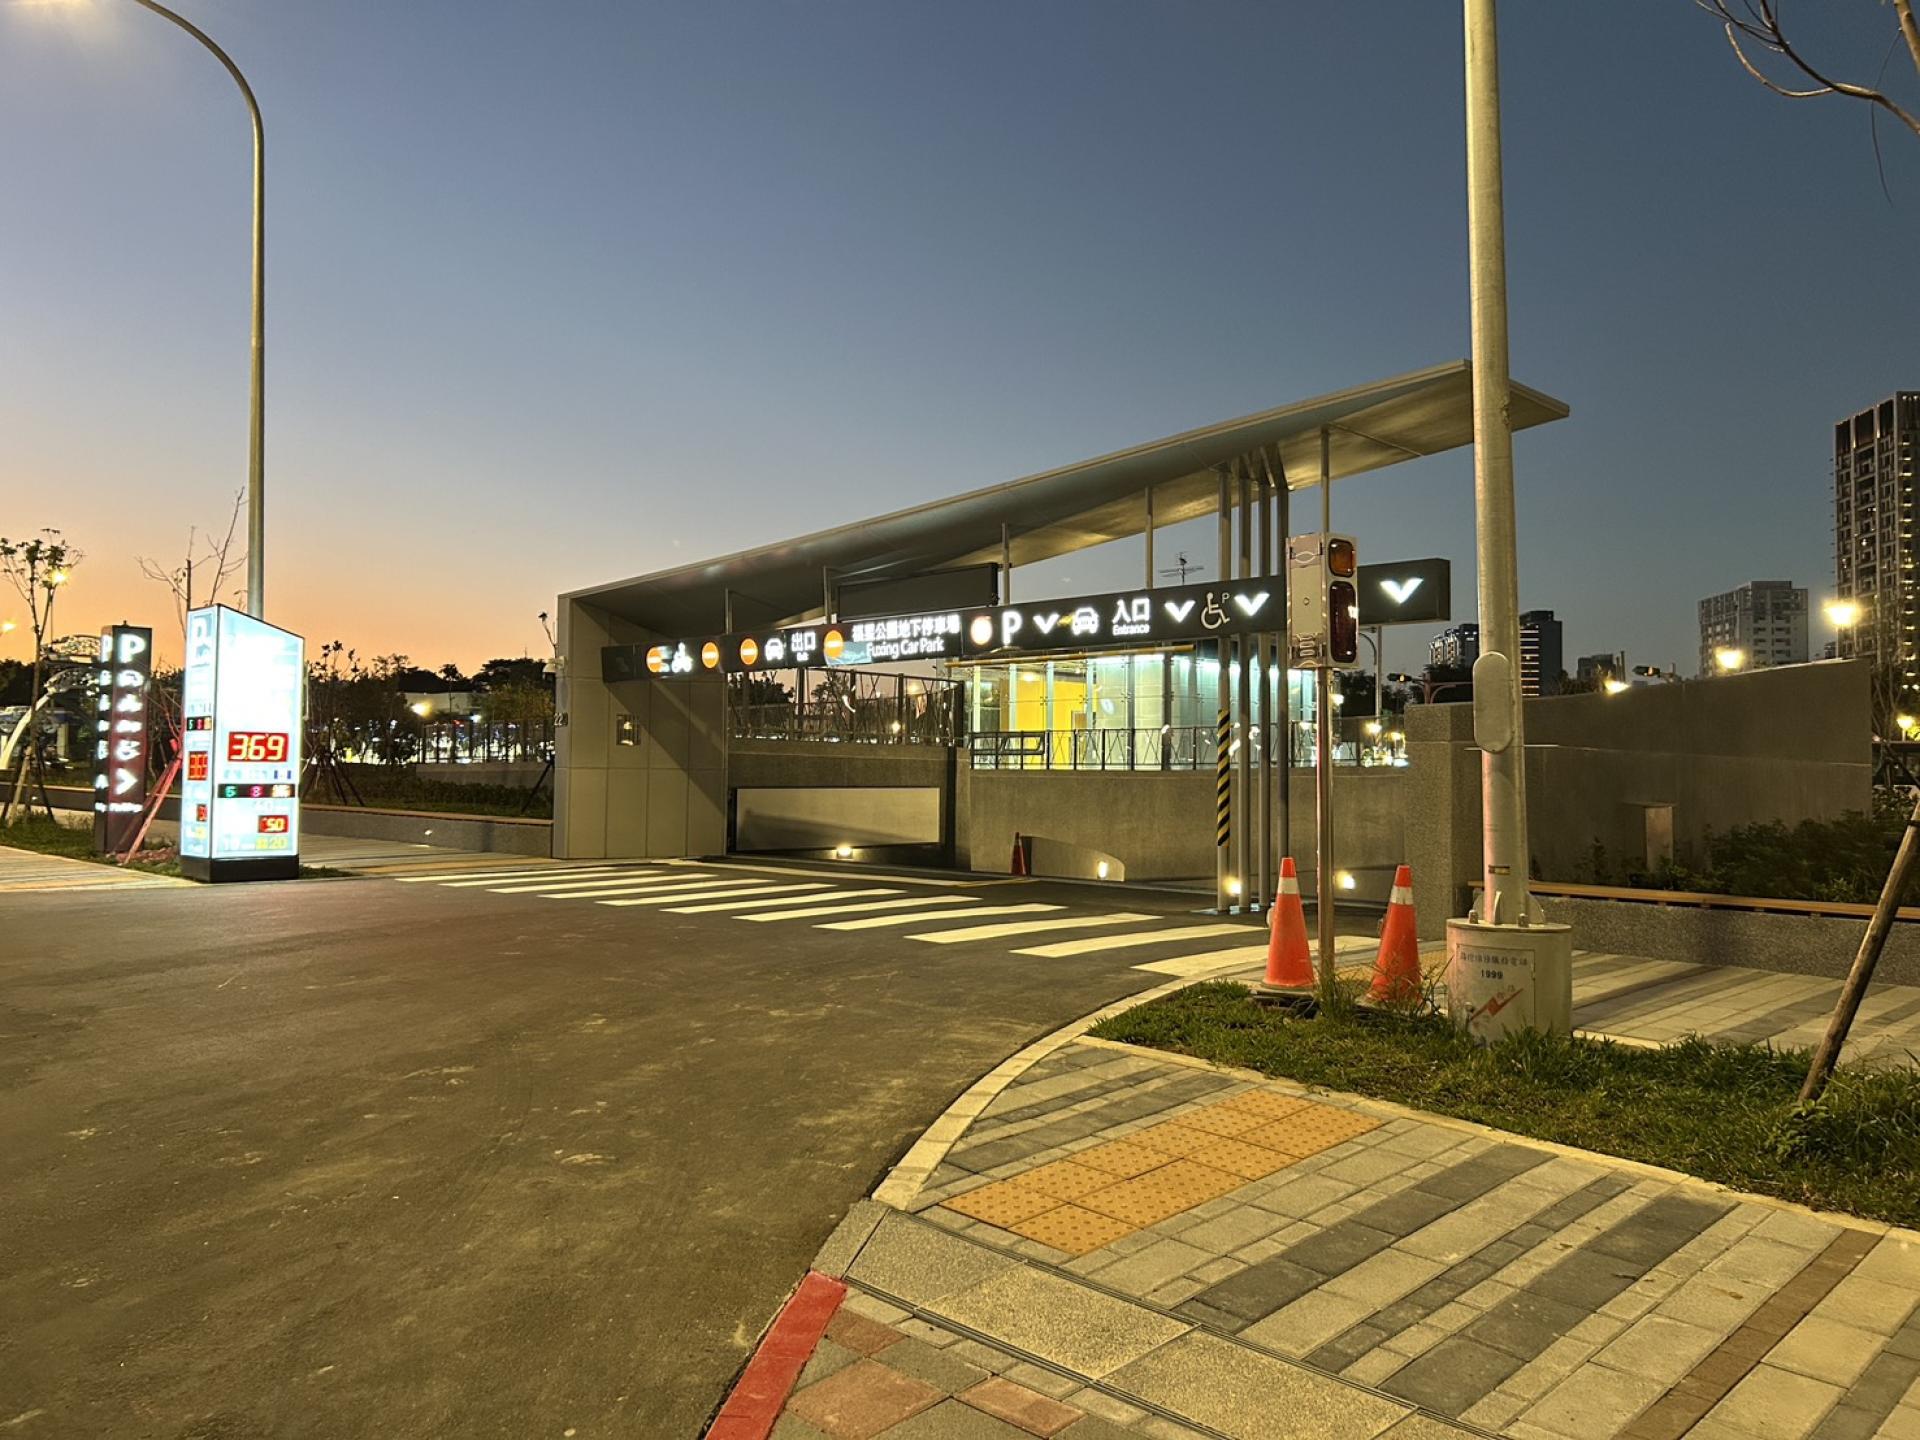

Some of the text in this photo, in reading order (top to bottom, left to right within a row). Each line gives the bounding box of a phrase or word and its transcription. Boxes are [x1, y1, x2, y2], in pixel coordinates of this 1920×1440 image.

[1112, 597, 1150, 623] 入口
[1002, 610, 1023, 645] P
[1112, 623, 1150, 636] Entrance
[117, 633, 146, 663] P
[791, 632, 816, 652] 出口
[866, 636, 945, 659] Fuxing Car Park
[230, 733, 284, 761] 369
